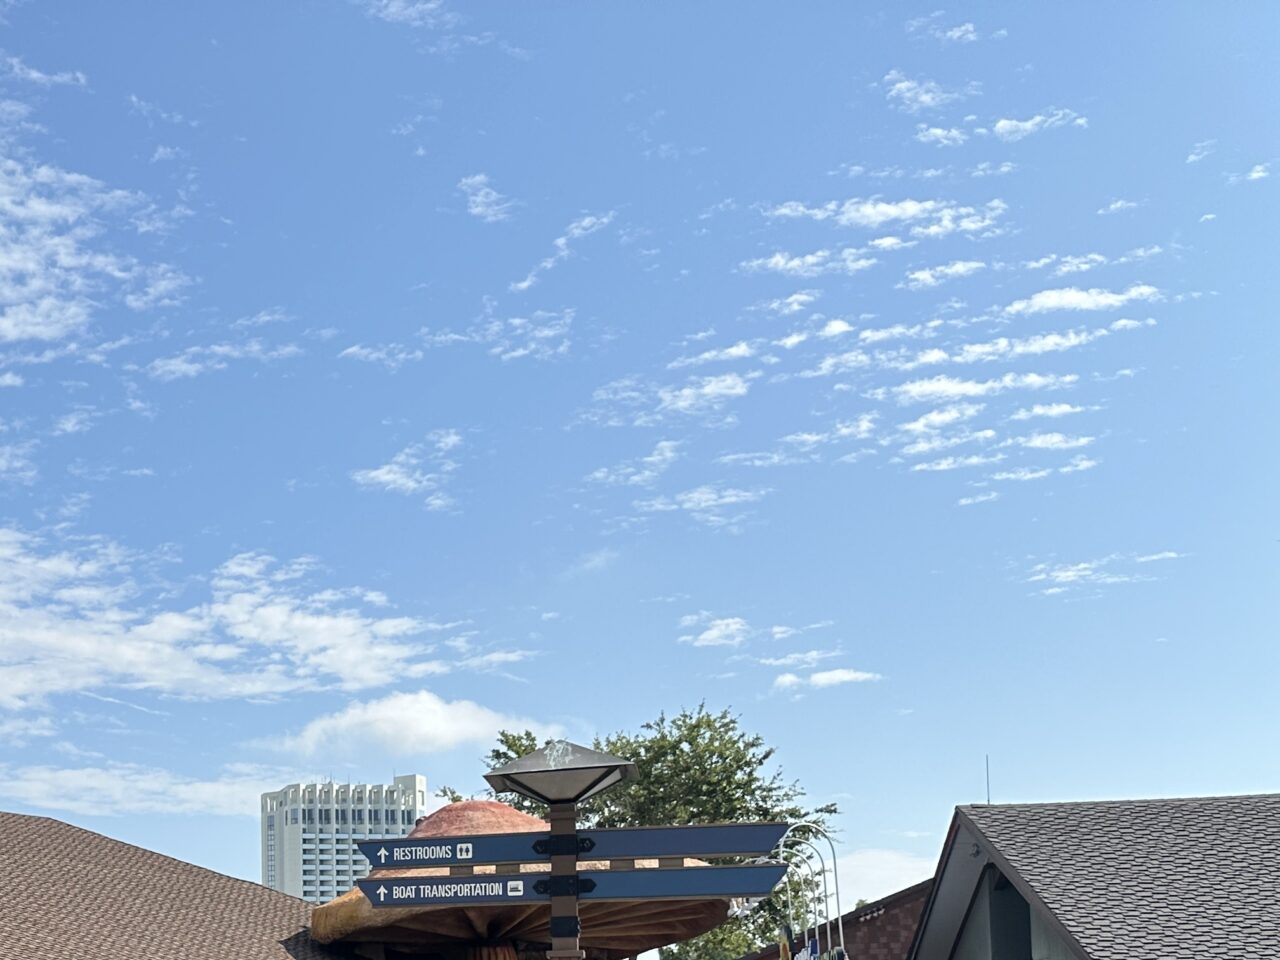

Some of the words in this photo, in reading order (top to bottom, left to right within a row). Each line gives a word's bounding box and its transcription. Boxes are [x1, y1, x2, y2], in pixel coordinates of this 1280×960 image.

[393, 845, 452, 860] RESTROOMS
[393, 886, 416, 898] BOAT
[419, 883, 502, 897] TRANSPORTATION
